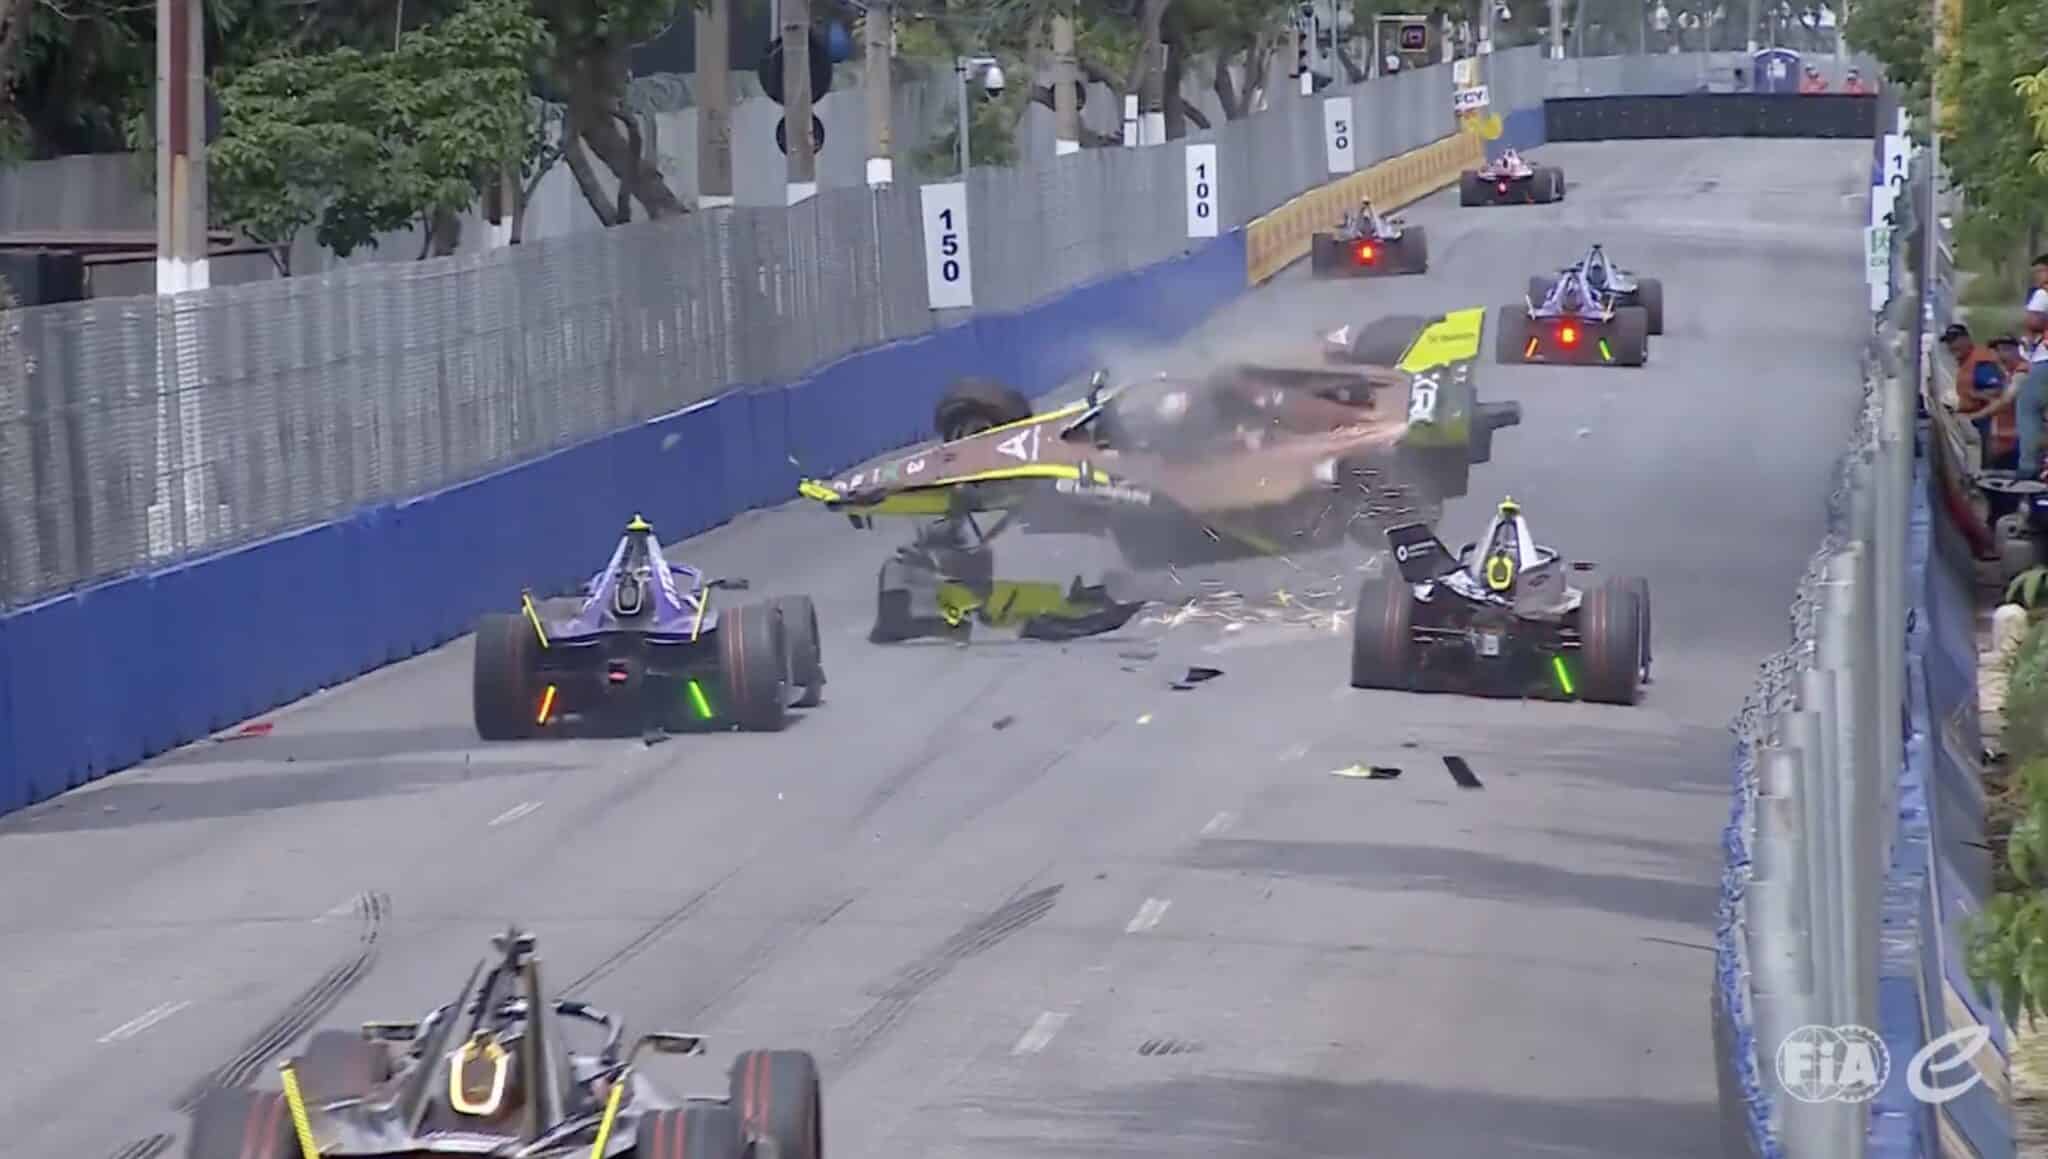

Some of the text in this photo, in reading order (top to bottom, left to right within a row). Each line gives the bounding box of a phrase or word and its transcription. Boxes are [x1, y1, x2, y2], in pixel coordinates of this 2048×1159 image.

[1335, 119, 1349, 150] 50
[1196, 163, 1209, 219] 100
[939, 208, 960, 282] 150
